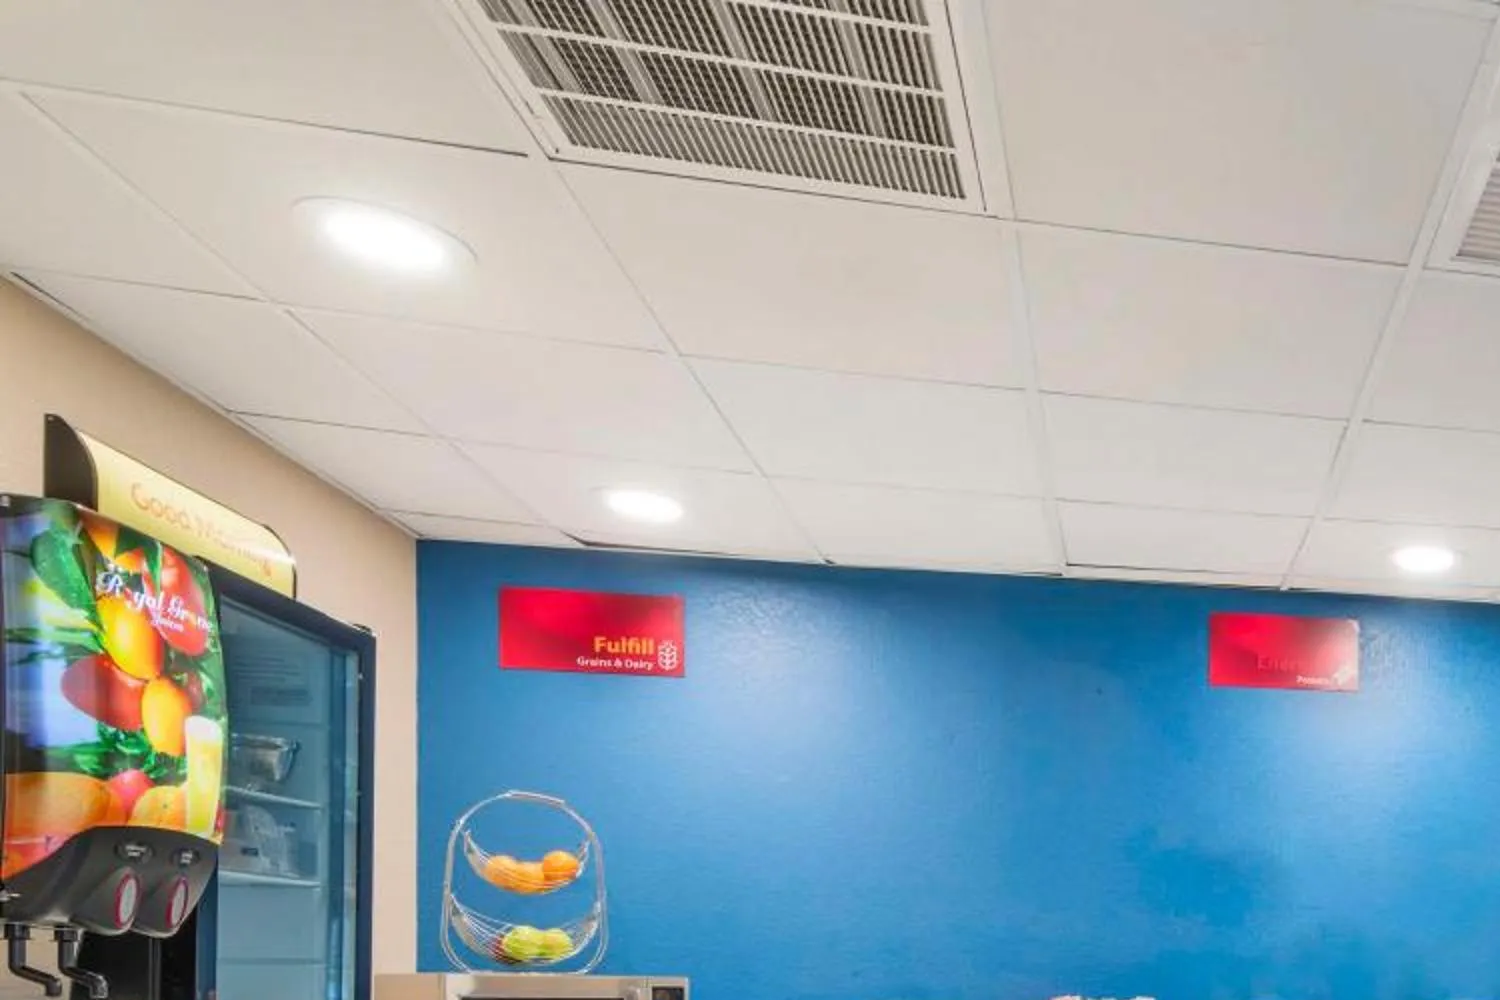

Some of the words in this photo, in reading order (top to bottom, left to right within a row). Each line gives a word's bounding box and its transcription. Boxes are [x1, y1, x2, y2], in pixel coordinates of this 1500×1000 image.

[594, 636, 655, 655] Fulfill
[577, 656, 612, 668] Grains
[613, 657, 622, 668] &
[625, 657, 653, 671] Dairy
